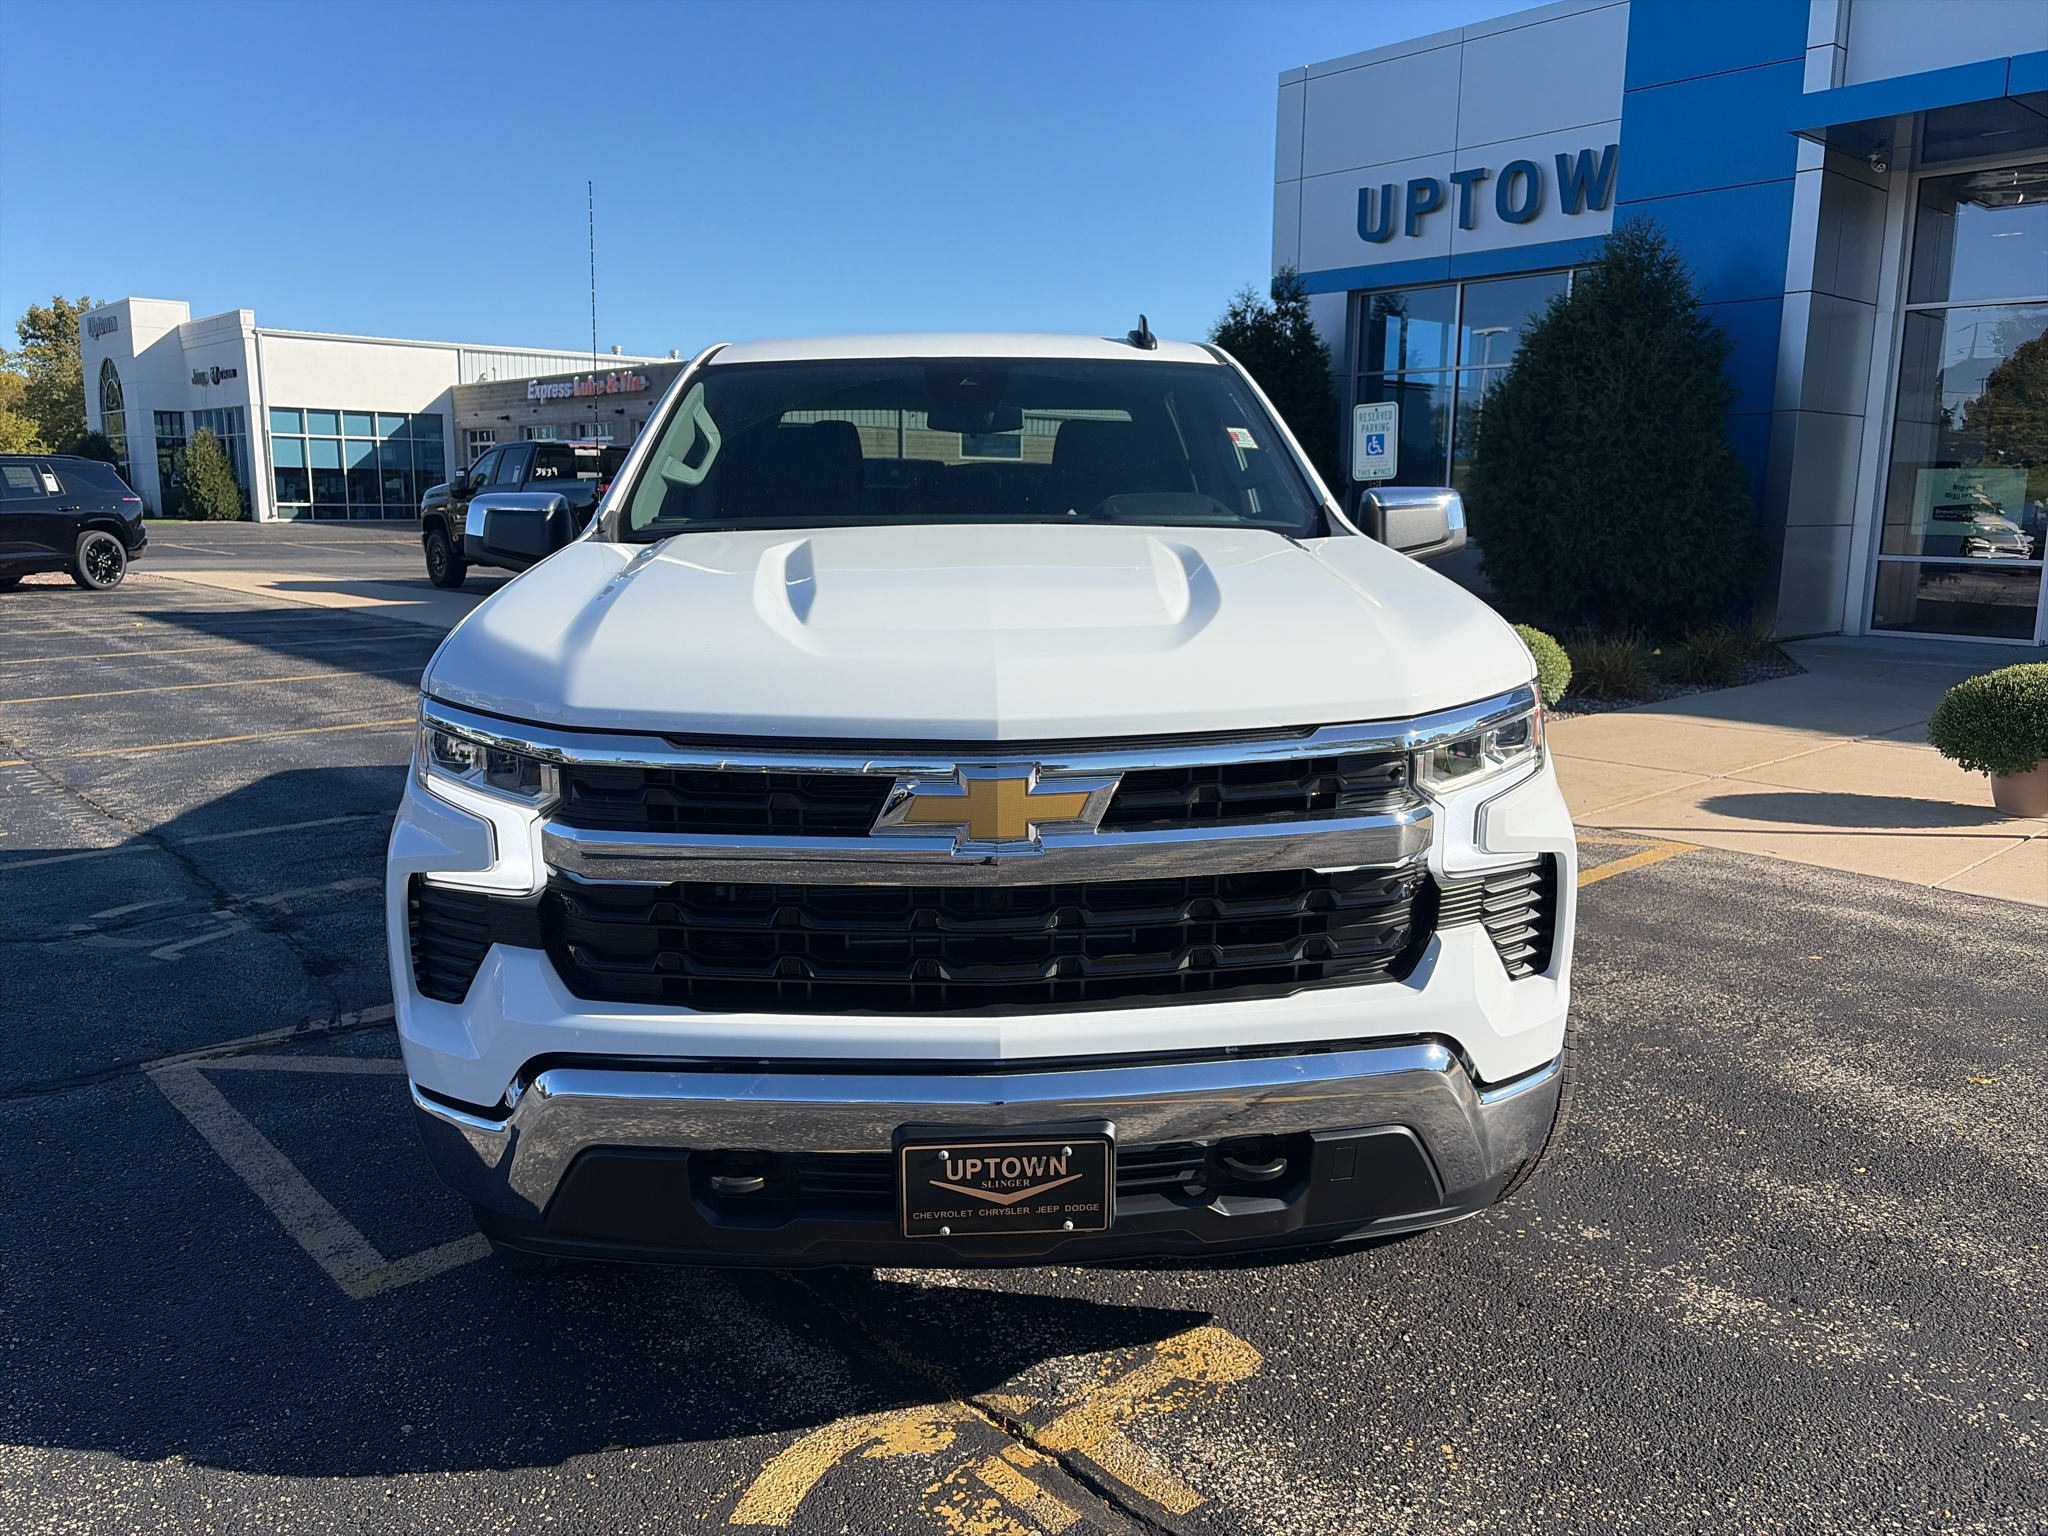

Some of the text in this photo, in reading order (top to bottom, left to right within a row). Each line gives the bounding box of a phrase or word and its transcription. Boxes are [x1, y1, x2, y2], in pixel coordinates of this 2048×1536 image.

[527, 370, 649, 405] Express Lube & Tire
[1359, 410, 1393, 422] RESERVED
[1361, 422, 1390, 433] PARKING
[1357, 467, 1392, 478] THIS SPACE
[946, 1155, 1067, 1181] UPTOWN
[981, 1178, 1031, 1189] SLINGER
[912, 1203, 1100, 1220] CHEVROLET CHRYSLER JEEP DODGE
